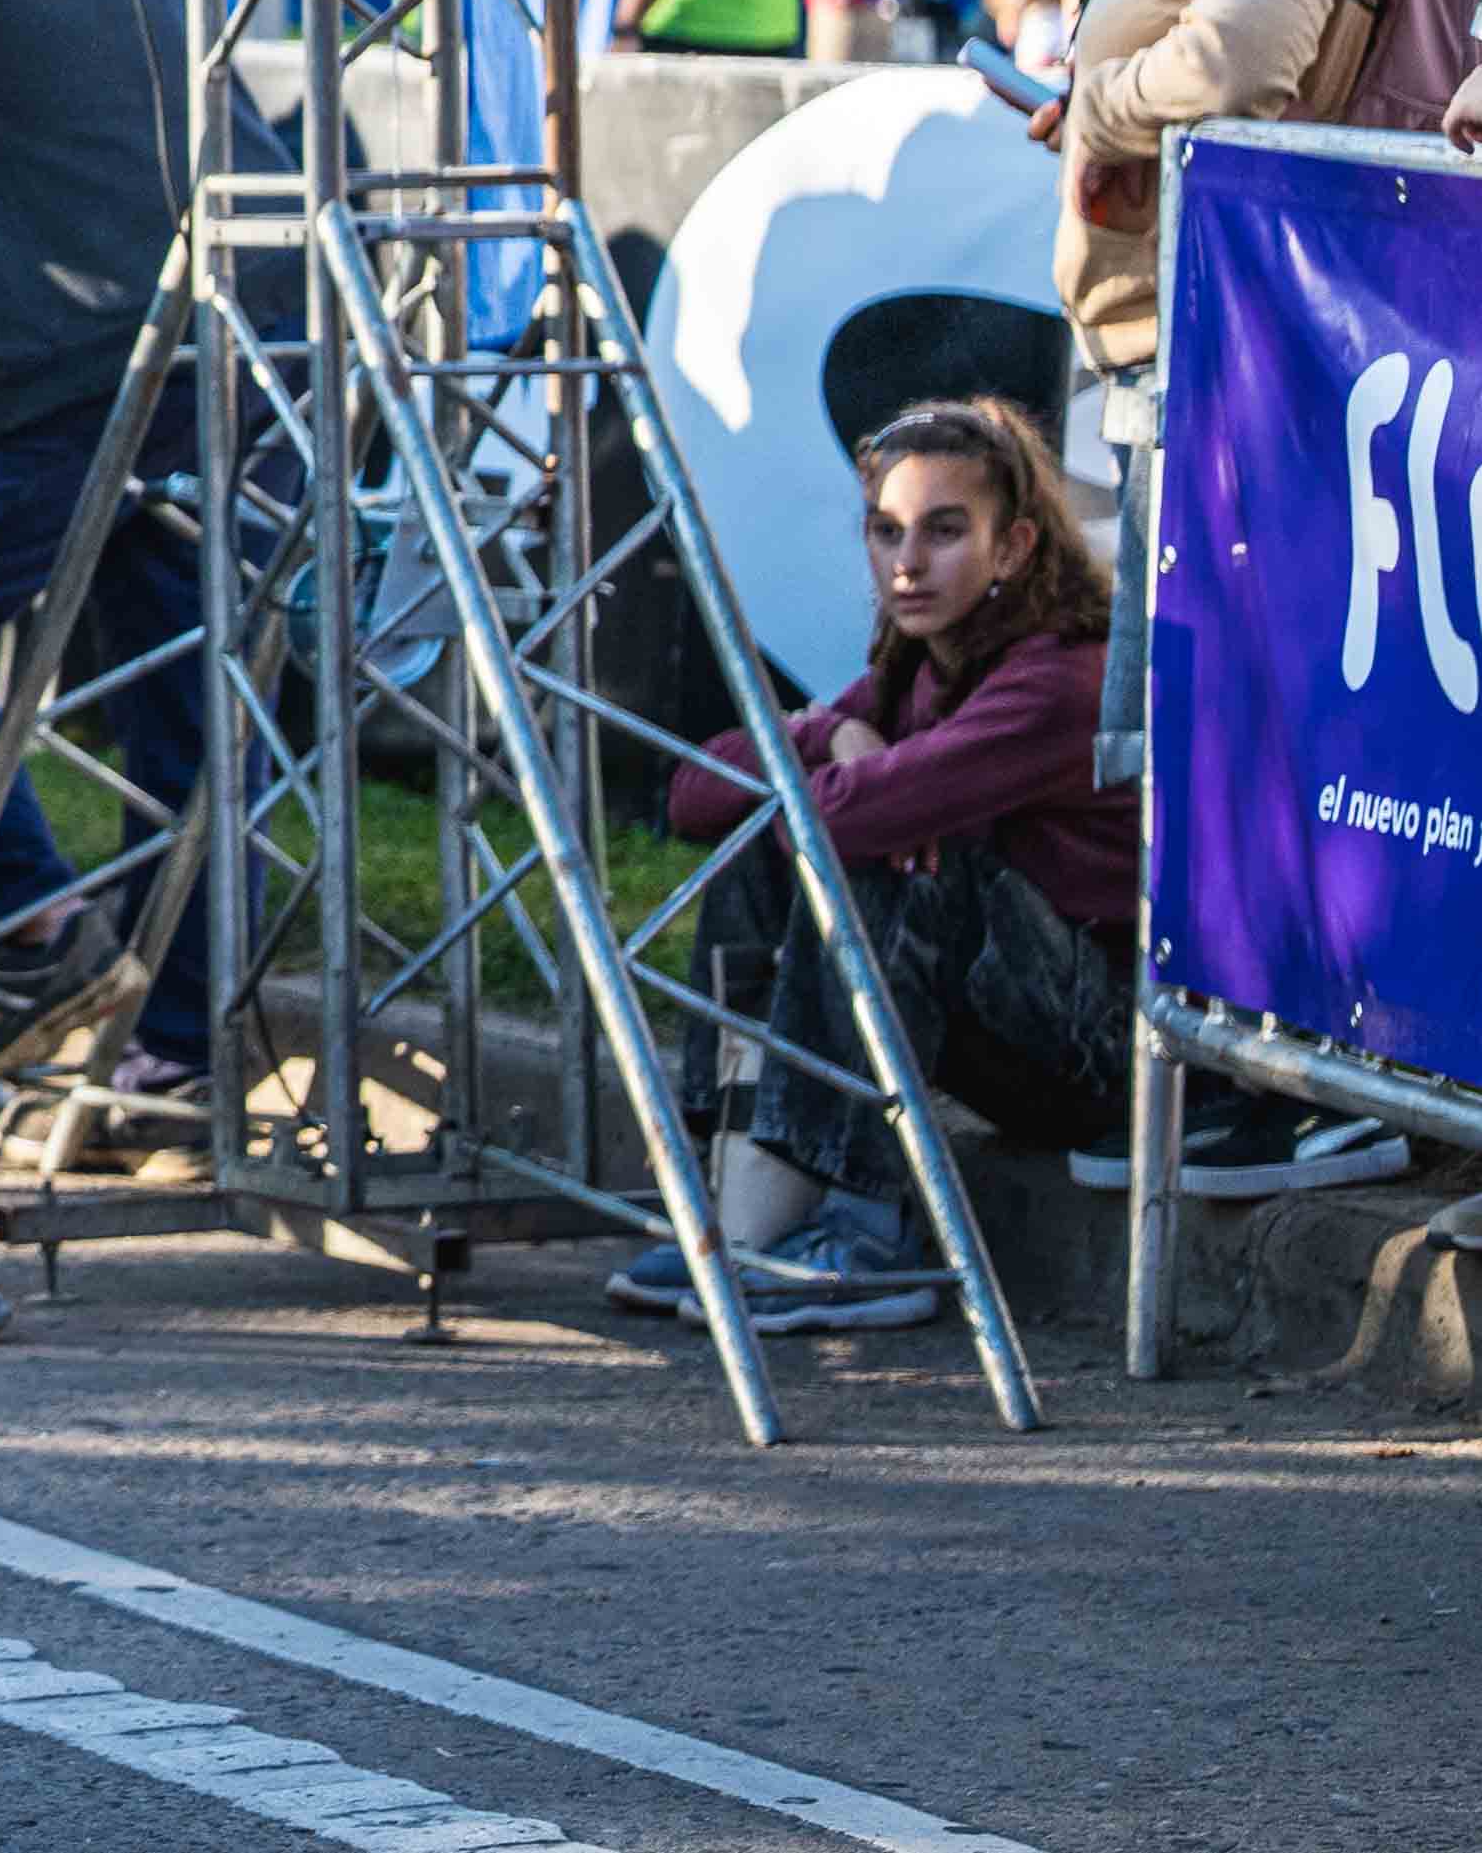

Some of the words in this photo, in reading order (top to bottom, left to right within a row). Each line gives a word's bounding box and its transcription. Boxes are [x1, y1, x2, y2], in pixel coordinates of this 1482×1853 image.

[1318, 773, 1347, 824] el
[1346, 789, 1421, 840] nuevo
[1422, 795, 1474, 858] plan
